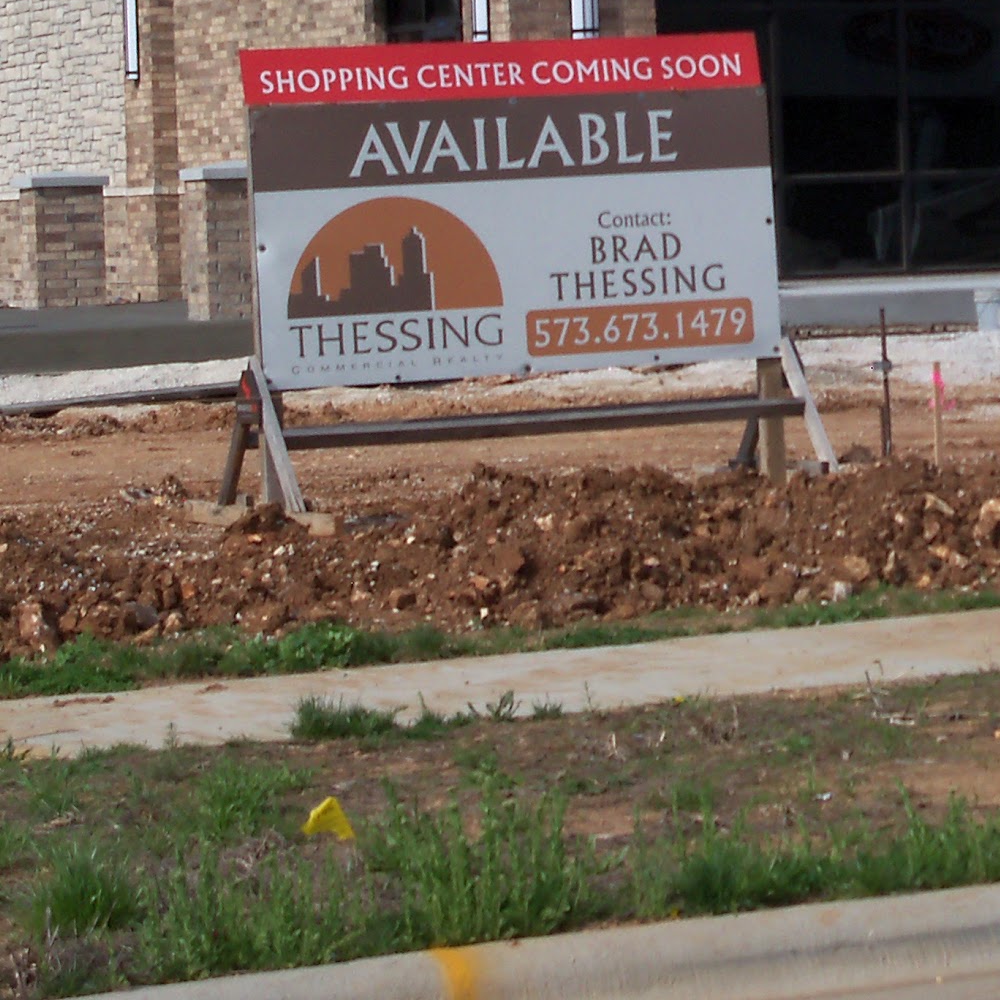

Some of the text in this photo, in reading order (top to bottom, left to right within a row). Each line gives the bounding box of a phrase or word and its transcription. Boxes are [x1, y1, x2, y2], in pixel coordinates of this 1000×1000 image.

[259, 53, 742, 95] SHOPPING CENTER COMING SOON
[349, 109, 678, 178] AVAILABLE
[598, 210, 671, 229] Contact:
[590, 232, 682, 265] BRAD
[550, 264, 726, 301] THESSING
[289, 314, 504, 359] THESSING
[535, 307, 747, 349] 573.673.1479
[291, 353, 504, 375] COMMERCIAL REALTY
